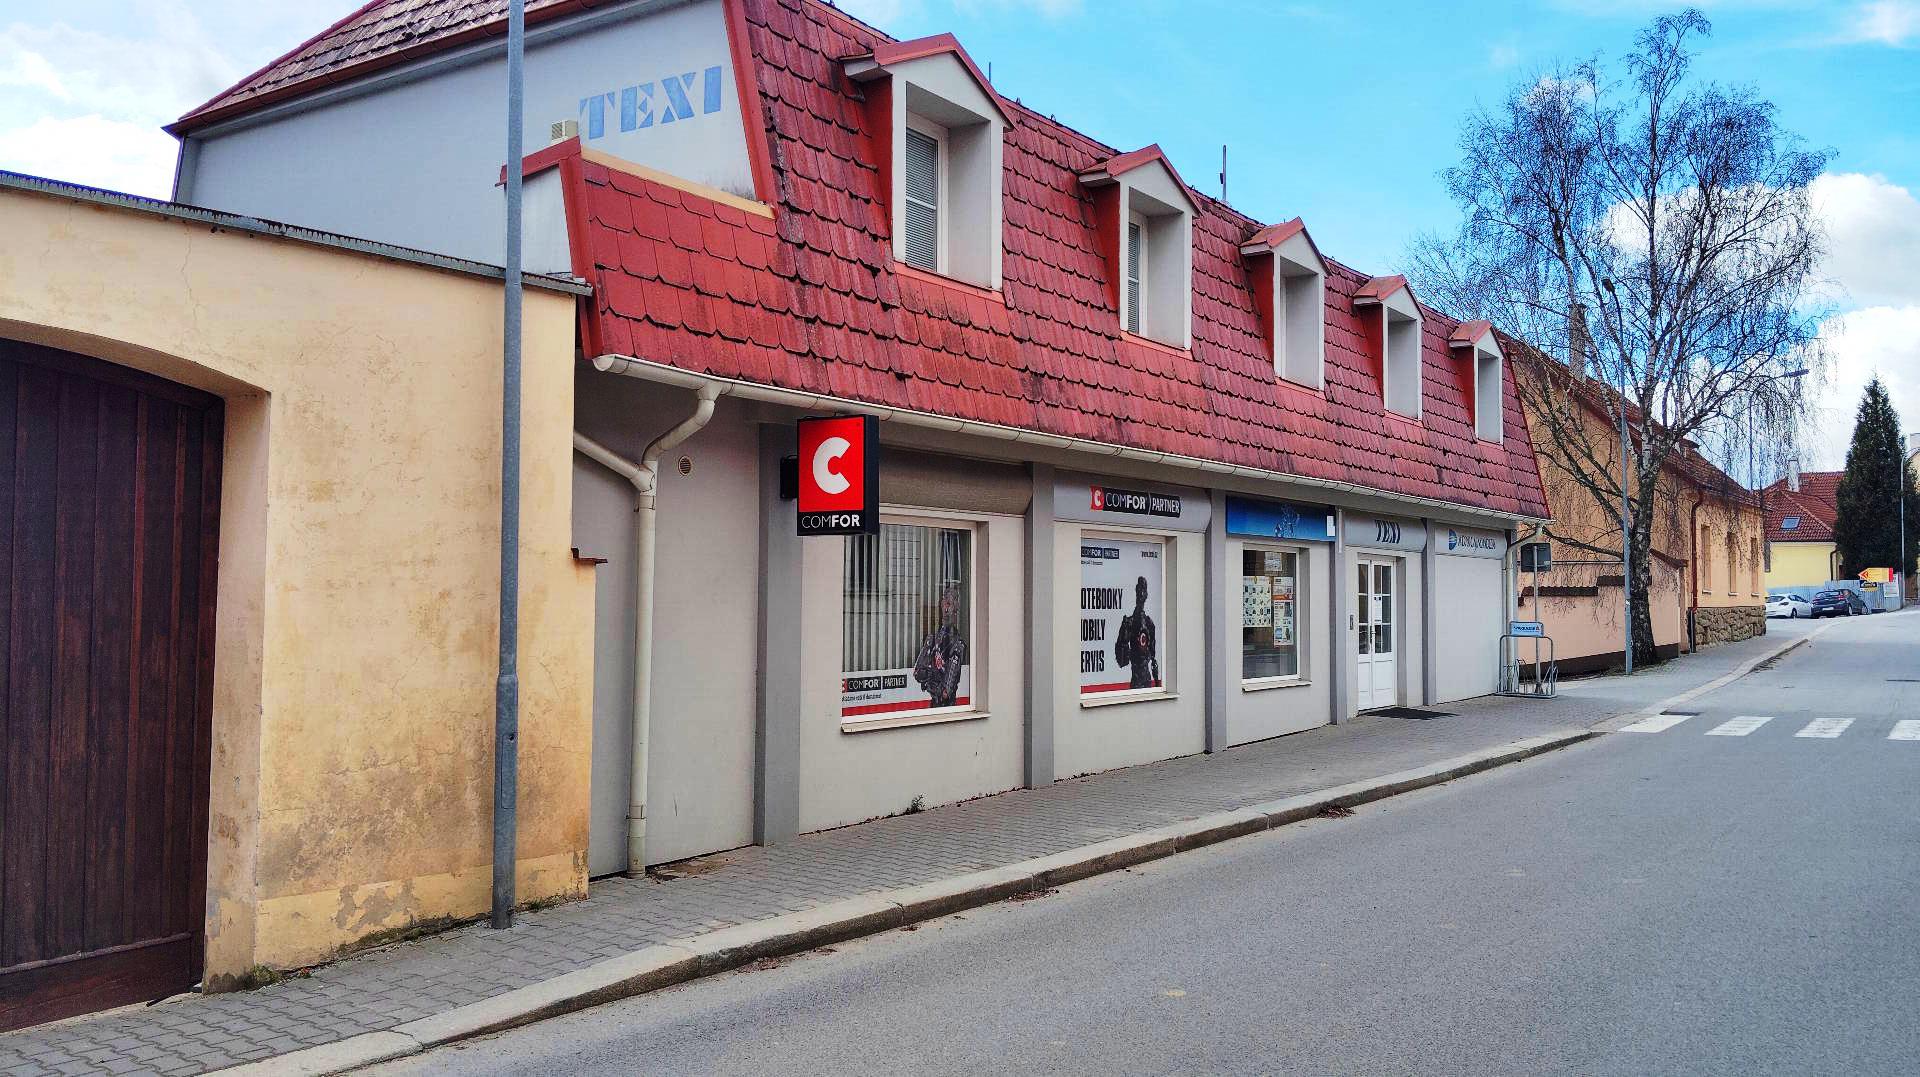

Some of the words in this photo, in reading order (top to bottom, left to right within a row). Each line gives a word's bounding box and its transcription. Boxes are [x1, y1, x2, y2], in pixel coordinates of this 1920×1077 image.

[580, 66, 722, 140] TEXI
[812, 437, 851, 495] C
[1106, 493, 1146, 510] COMFOR
[1152, 497, 1180, 514] PARTNER
[802, 514, 860, 529] COMFOR
[1081, 619, 1105, 642] OBILY
[848, 679, 879, 690] COMFOR
